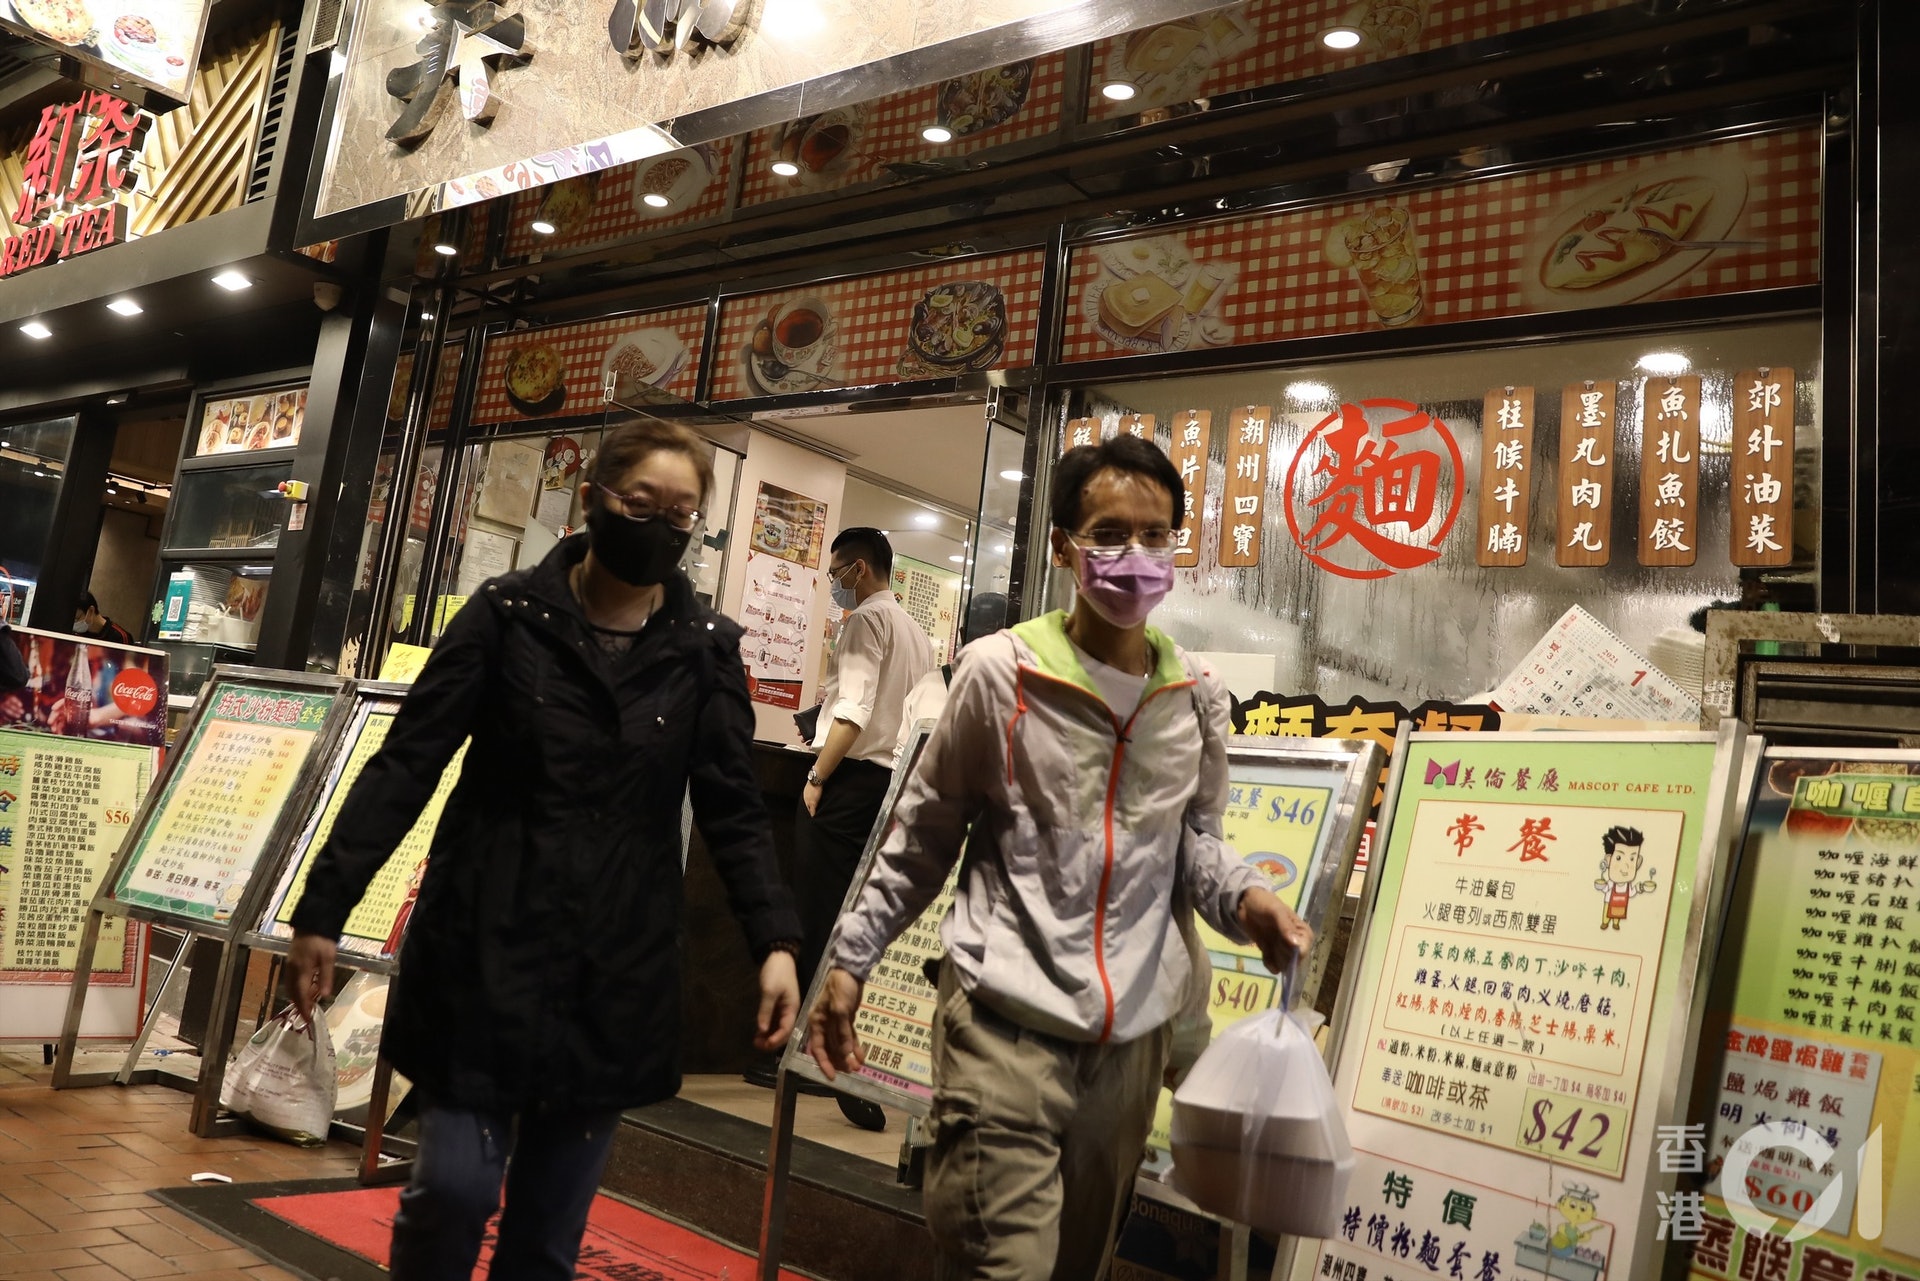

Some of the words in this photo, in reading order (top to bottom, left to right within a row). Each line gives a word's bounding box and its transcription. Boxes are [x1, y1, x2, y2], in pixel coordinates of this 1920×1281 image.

[12, 90, 141, 224] 紅茶
[0, 222, 56, 275] RED
[57, 202, 116, 260] TEA
[1486, 398, 1525, 555] 柱候牛腩
[1567, 391, 1607, 553] 墨丸肉丸
[1648, 386, 1692, 552] 魚扎魚餃
[1743, 380, 1784, 555] 郊外油菜
[1233, 416, 1266, 558] 潮州四寶
[1302, 401, 1443, 570] 麵
[1533, 663, 1545, 675] 10
[1546, 652, 1554, 660] 3
[1602, 649, 1619, 664] 2021
[1521, 676, 1534, 687] 17
[1552, 680, 1564, 691] 11
[1565, 668, 1573, 676] 4
[1630, 670, 1647, 687] 1
[113, 682, 156, 700] Coca-Cola
[1539, 692, 1552, 704] 18
[1571, 696, 1584, 708] 12
[1584, 684, 1593, 693] 5
[216, 690, 305, 724] 特式炒粉麵飯
[299, 705, 328, 724] 套餐
[1605, 702, 1614, 710] 6
[1458, 767, 1560, 793] 美倫餐廳
[1568, 780, 1620, 792] MASCOT
[1625, 782, 1660, 793] CAFE
[1667, 783, 1696, 795] LTD.
[30, 800, 79, 811] 梅菜扣肉飯
[105, 809, 130, 825] $56
[1267, 796, 1320, 826] $46
[1446, 812, 1558, 863] 常餐
[1455, 876, 1516, 901] 牛油餐包
[1814, 868, 1913, 889] 咖喱豬扒
[1809, 888, 1920, 909] 咖喱石班
[1805, 907, 1904, 931] 咖喱雞飯
[1212, 977, 1260, 1013] $40
[1792, 967, 1919, 1000] 咖喱牛腩飯
[866, 991, 918, 1016] 各式三文治
[1788, 988, 1915, 1022] 咖喱牛肉飯
[859, 1010, 901, 1029] 各式多士
[1783, 1007, 1914, 1044] 咖喱煎蛋什菜飯
[1723, 1029, 1846, 1074] 金牌鹽焗雞
[1404, 1070, 1491, 1111] 咖啡或茶
[1722, 1071, 1845, 1118] 鹽焗雞飯
[1430, 1109, 1476, 1133] 改多士加
[1479, 1121, 1494, 1135] $1
[1523, 1097, 1611, 1159] $42
[1382, 1169, 1478, 1231] 特價
[1744, 1174, 1816, 1213] $60
